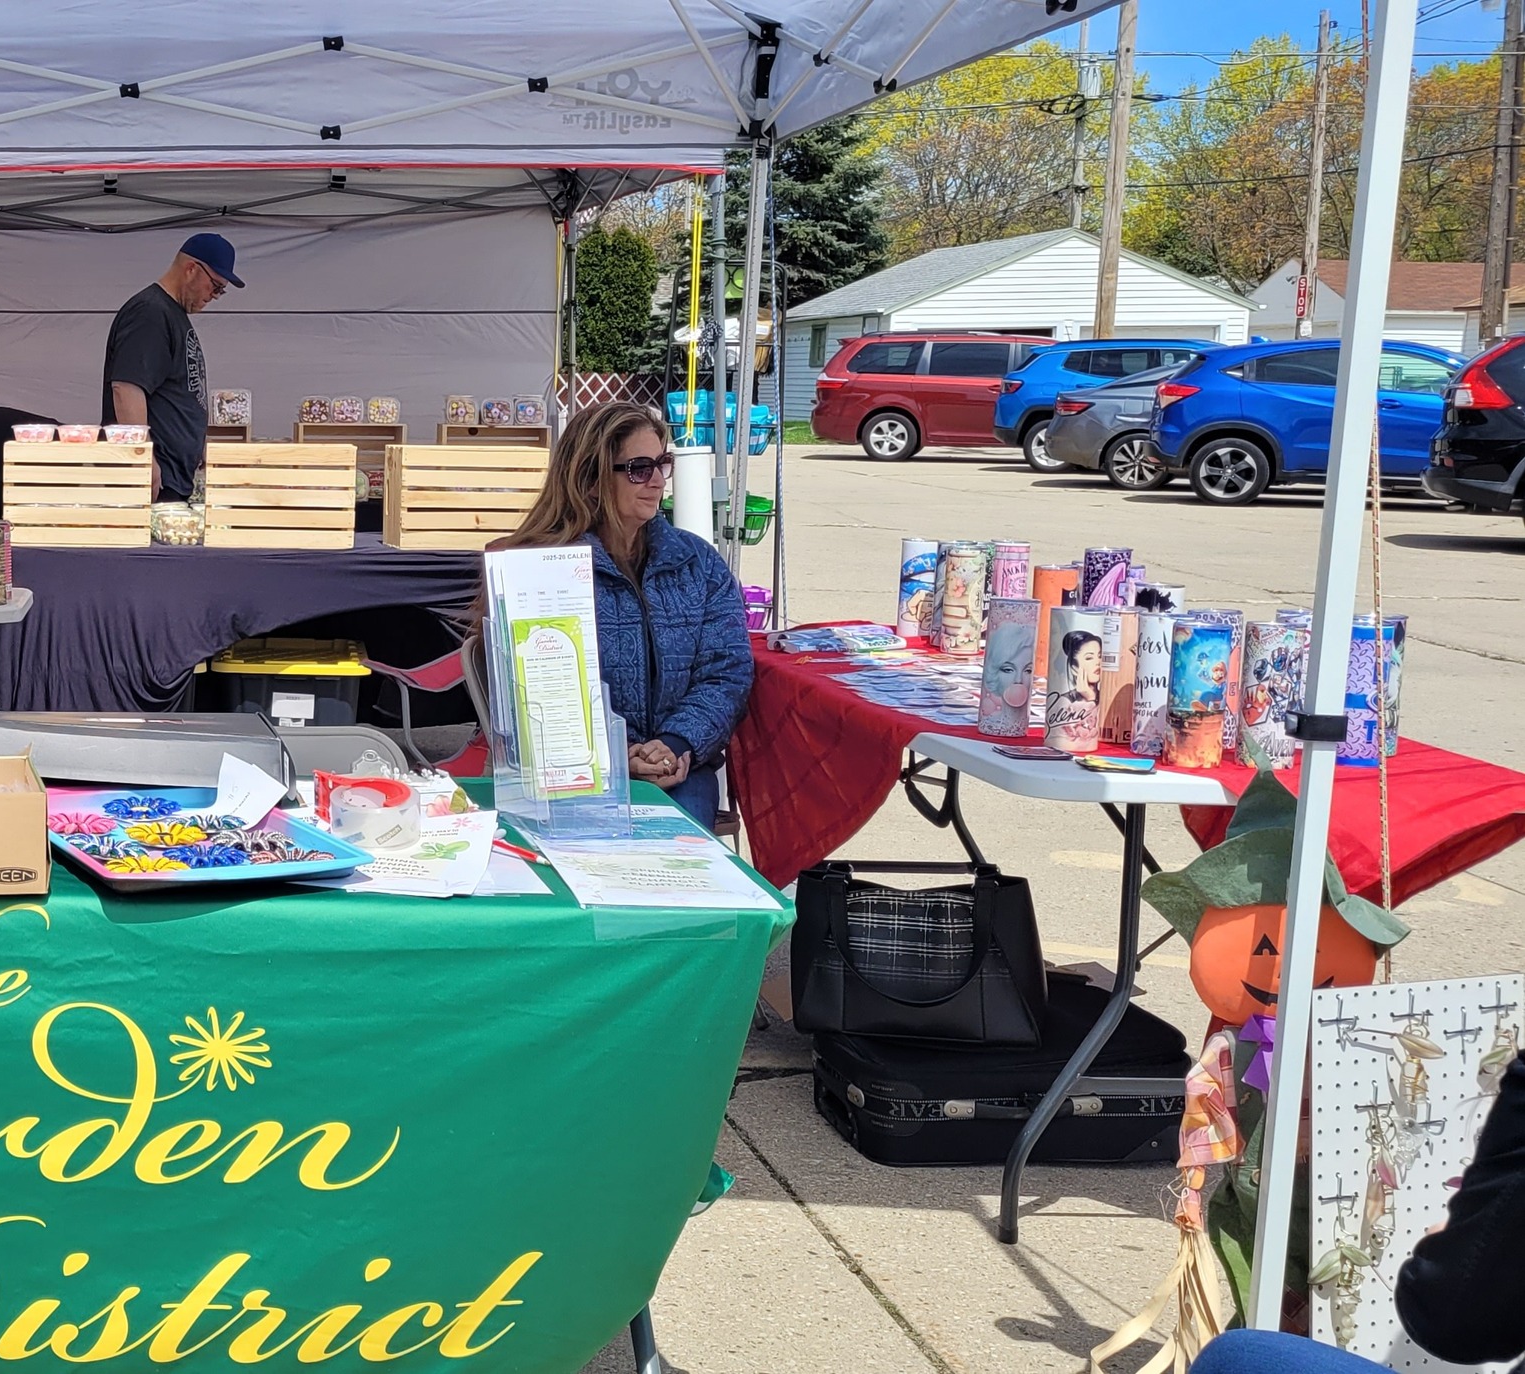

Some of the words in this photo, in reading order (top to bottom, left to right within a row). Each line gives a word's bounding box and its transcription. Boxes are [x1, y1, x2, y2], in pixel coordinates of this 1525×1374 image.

[1297, 278, 1306, 315] STOP
[377, 826, 401, 844] Scotch
[374, 857, 418, 865] PRING
